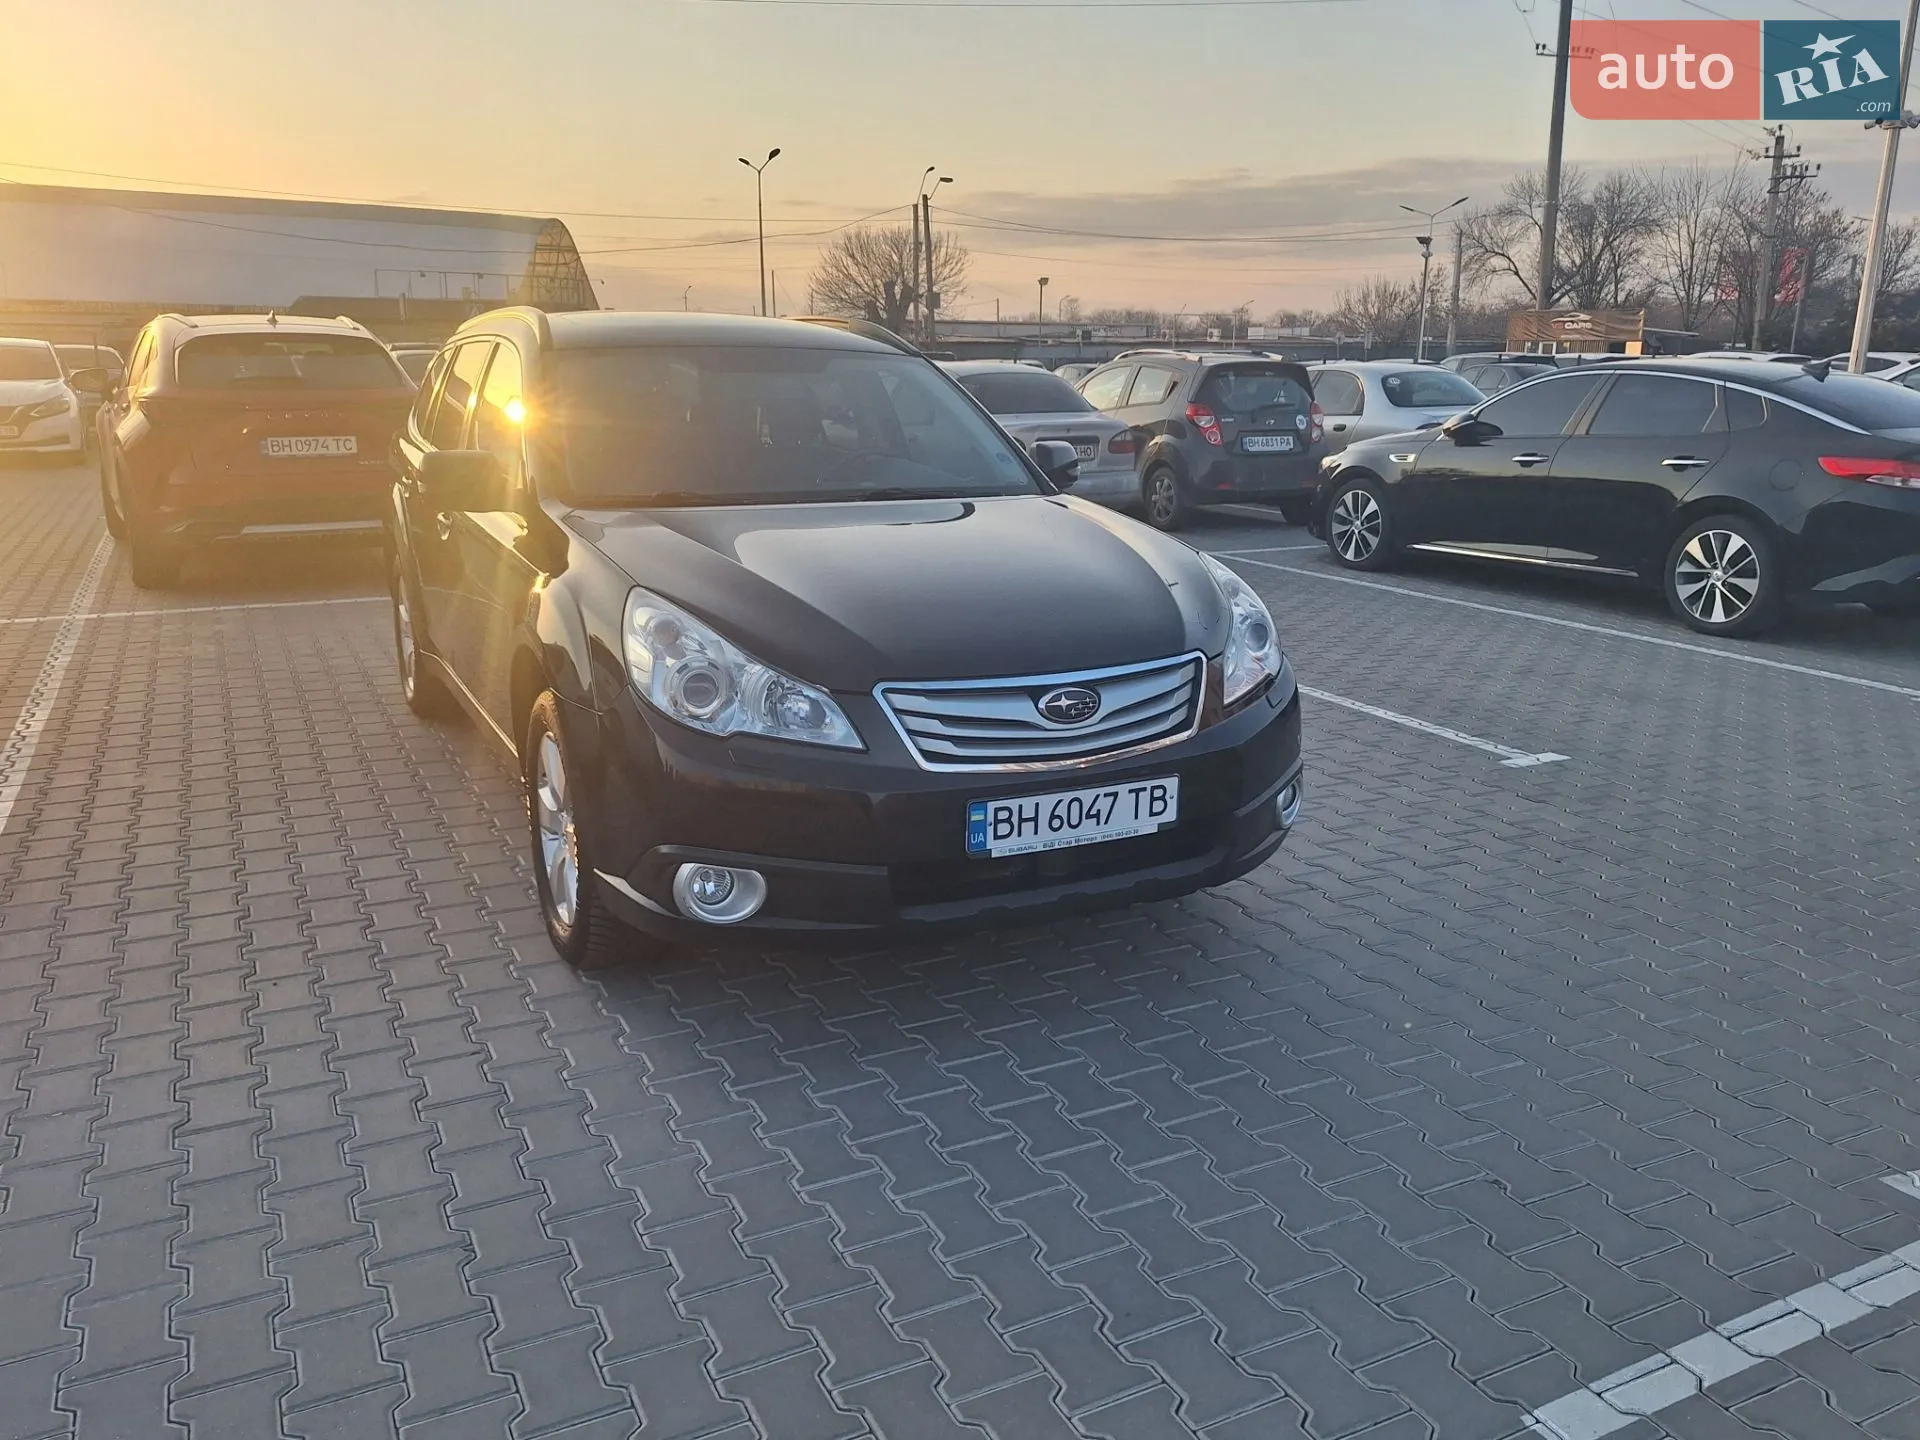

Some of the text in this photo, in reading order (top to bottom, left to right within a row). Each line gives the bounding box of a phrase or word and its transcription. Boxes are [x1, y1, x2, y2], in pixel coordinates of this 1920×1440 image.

[270, 438, 353, 453] BH 0974 TC
[1248, 437, 1291, 447] BH 6831 PA
[993, 784, 1168, 841] BH 6047 TB
[970, 832, 985, 844] UA
